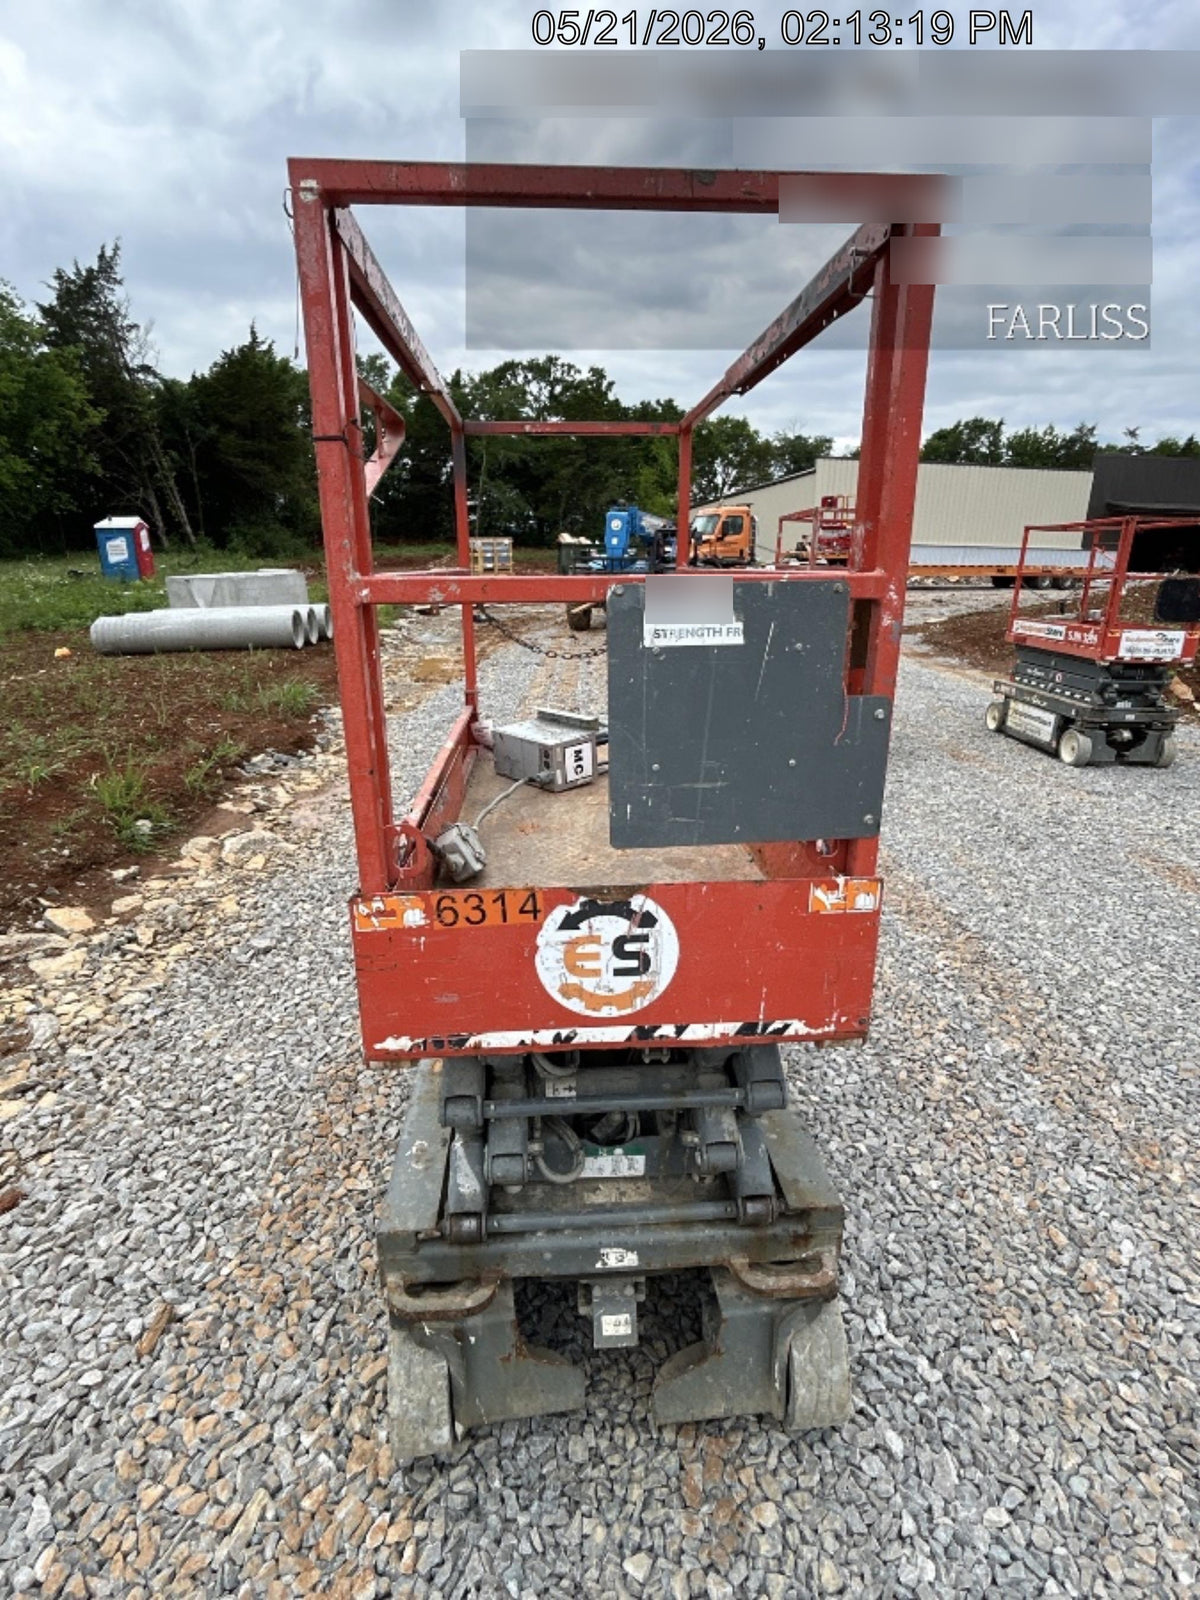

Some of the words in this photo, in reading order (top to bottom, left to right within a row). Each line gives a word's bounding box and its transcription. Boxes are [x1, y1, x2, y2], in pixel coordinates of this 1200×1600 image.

[653, 627, 723, 639] STRENGTH
[573, 749, 584, 776] MC
[435, 891, 542, 927] 6314
